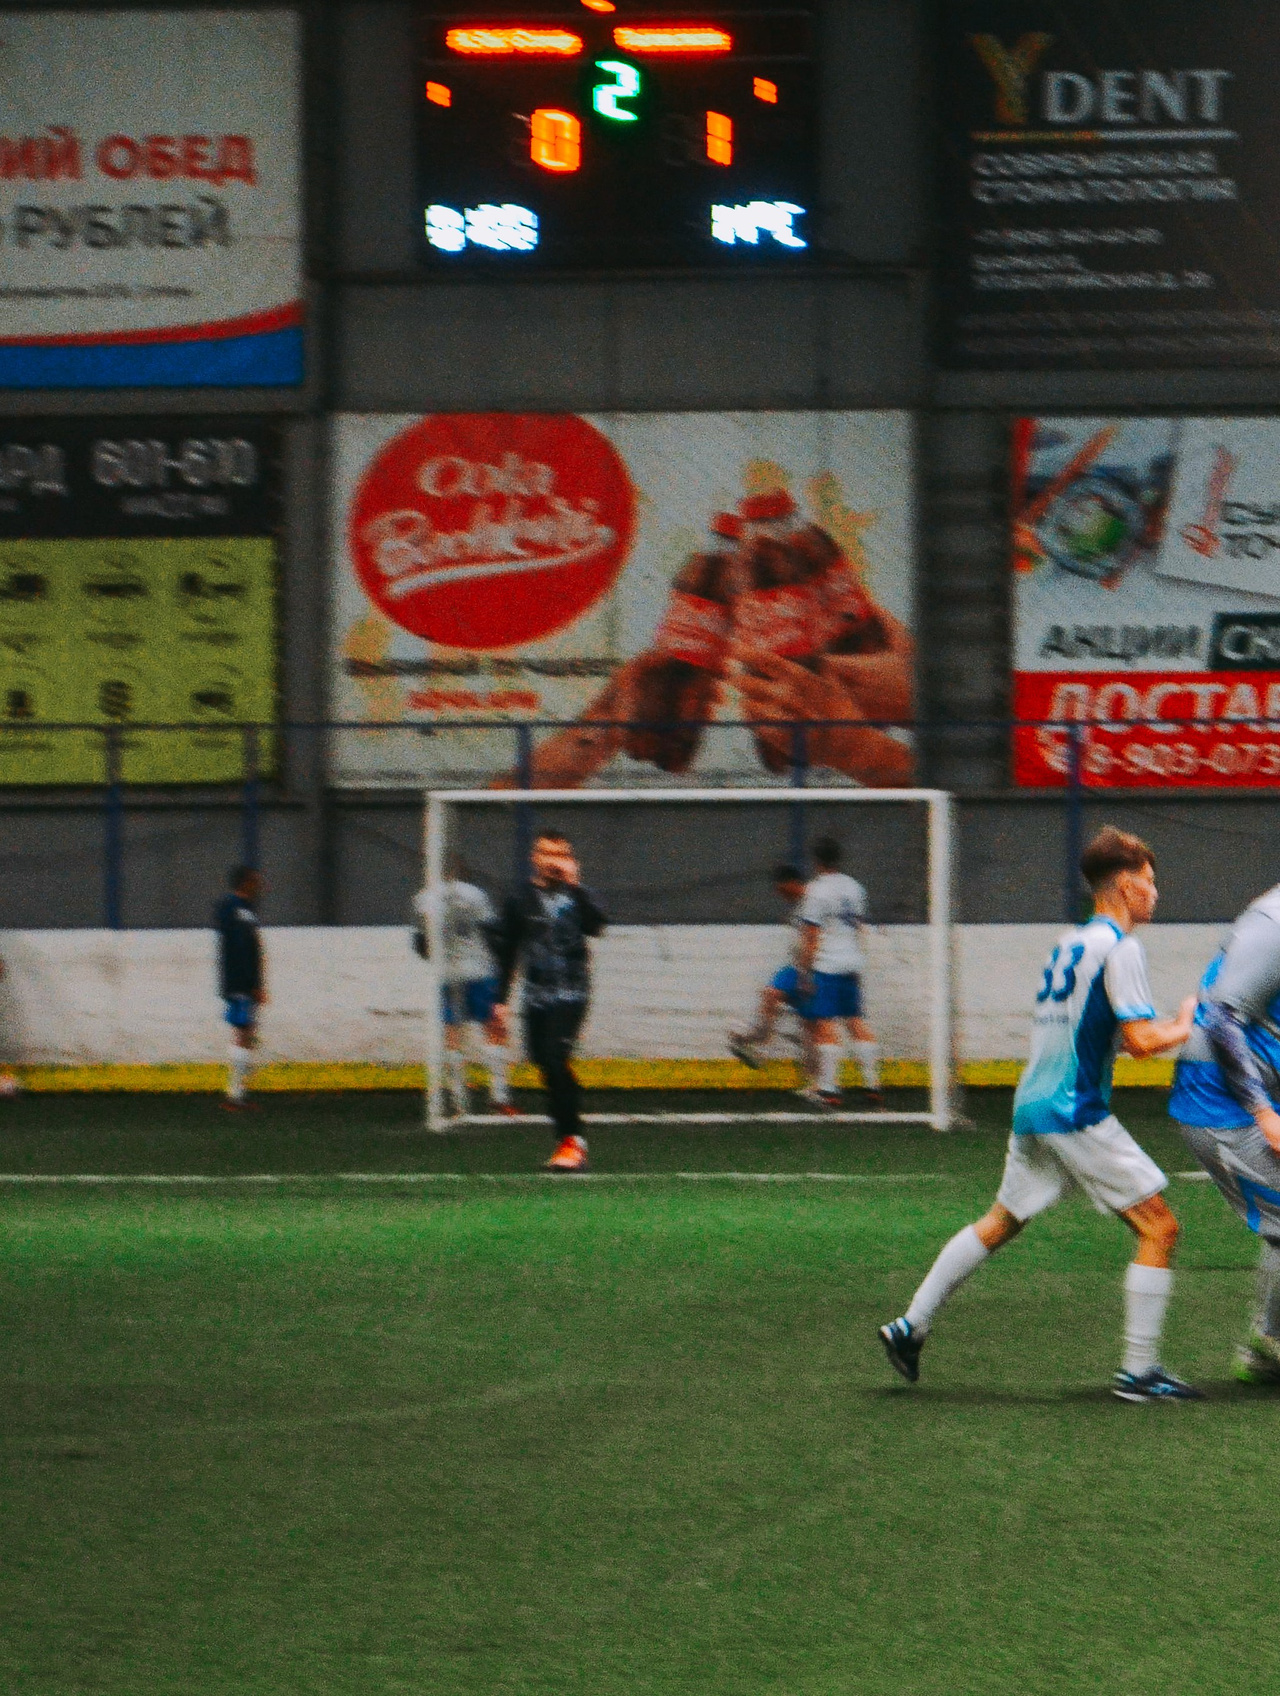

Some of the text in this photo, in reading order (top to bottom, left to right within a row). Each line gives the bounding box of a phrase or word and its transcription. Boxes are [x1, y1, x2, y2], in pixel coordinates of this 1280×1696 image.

[592, 59, 640, 121] 2
[97, 132, 259, 188] ОБЕД
[530, 108, 582, 172] 0
[13, 195, 233, 249] РУБЛЕЙ
[1040, 623, 1201, 667] АКЦИИ
